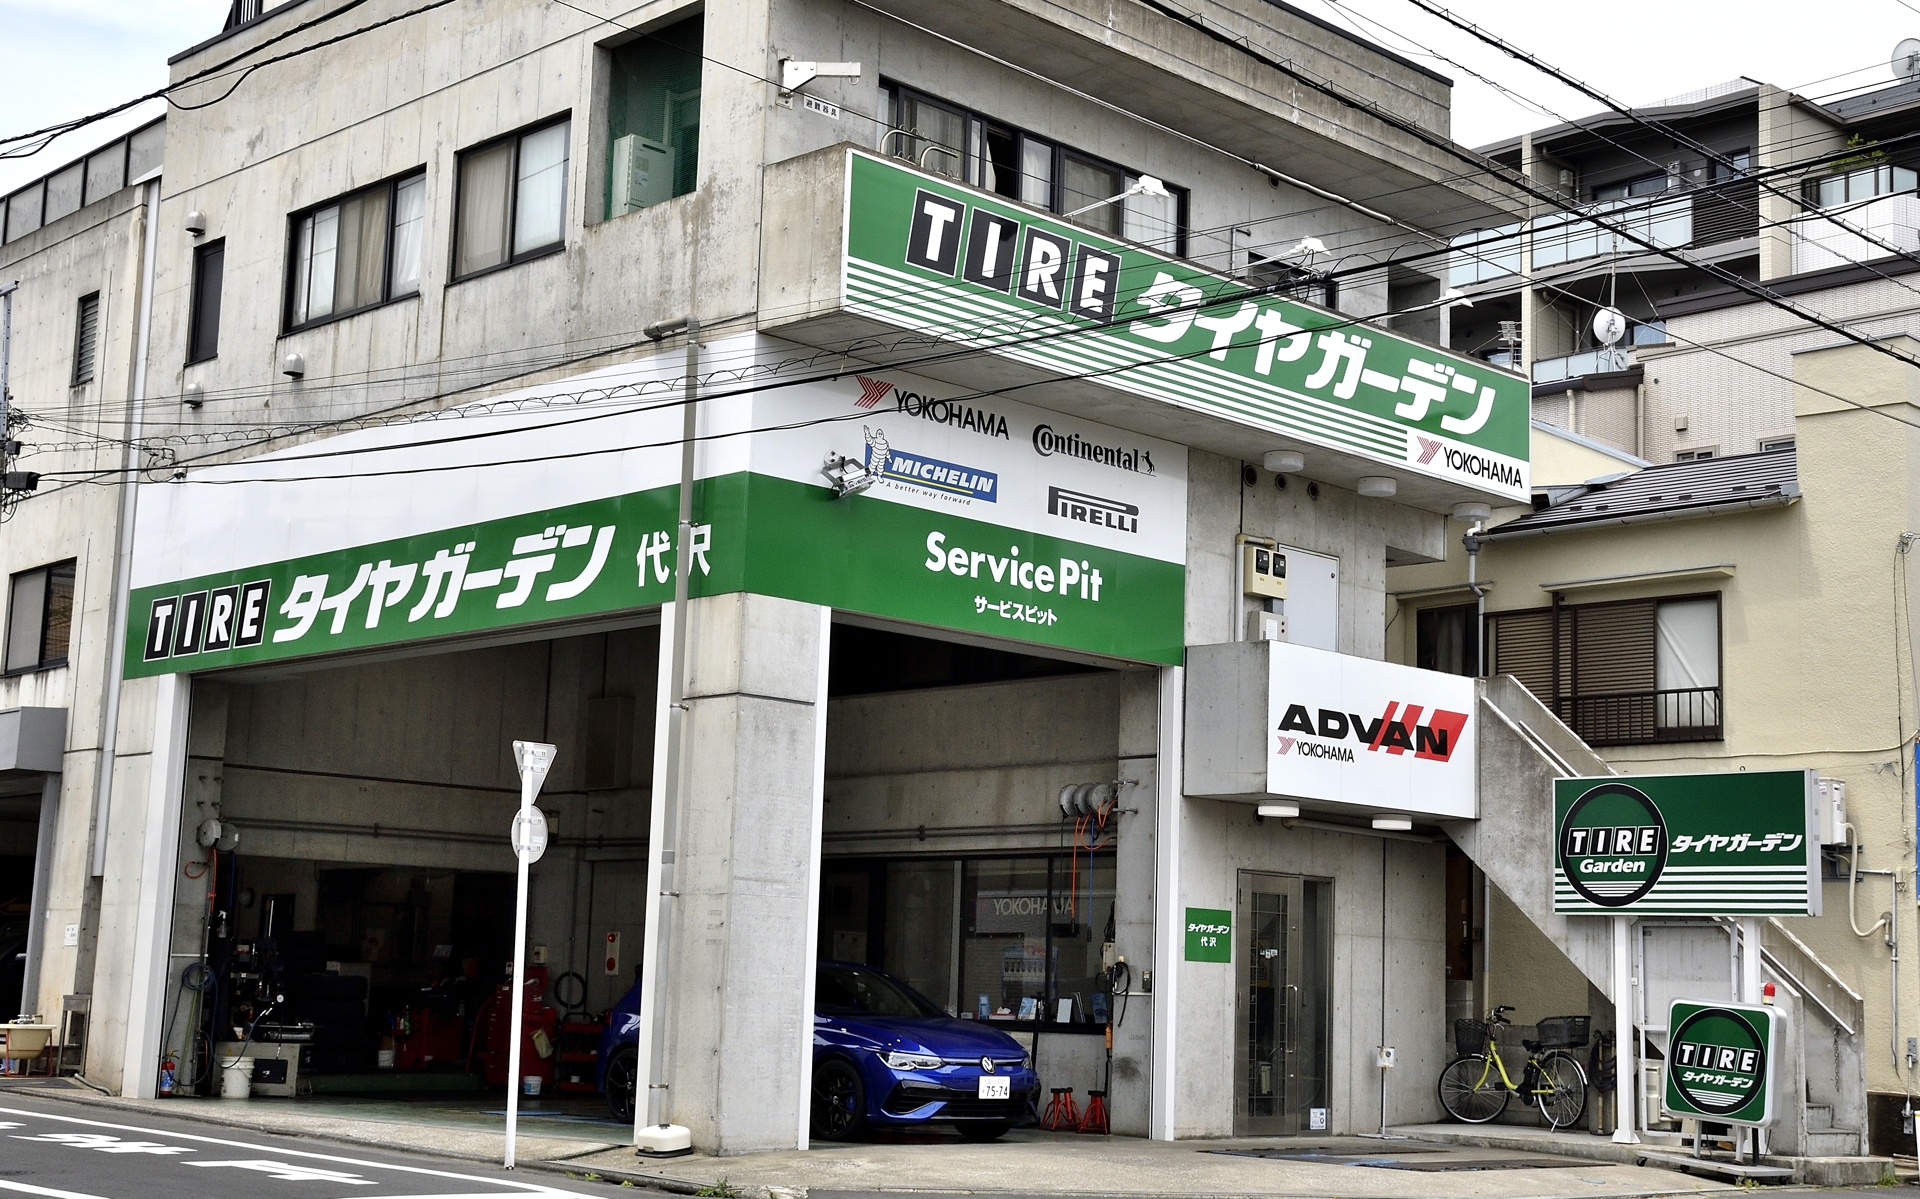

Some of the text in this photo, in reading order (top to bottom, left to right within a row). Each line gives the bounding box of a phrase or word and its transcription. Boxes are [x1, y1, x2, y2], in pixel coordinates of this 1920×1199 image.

[923, 200, 1496, 436] TIRE タイヤガーデン
[893, 388, 1010, 440] YOKOHAMA
[1032, 424, 1140, 473] Continental
[891, 457, 994, 493] MICHELIN
[1443, 446, 1523, 489] YOKOHAMA
[885, 481, 972, 506] A better way forward
[1047, 485, 1140, 534] PIRELLI
[924, 530, 1103, 602] Service Pit
[153, 588, 264, 652] TIRE
[272, 524, 616, 643] タイヤガーデン
[974, 595, 1058, 627] サービスピット
[1277, 703, 1448, 757] ADVAN
[1296, 740, 1355, 763] YOKOHAMA
[1572, 829, 1803, 853] TIRE タイヤガーデン
[1579, 858, 1646, 874] Garden
[1187, 923, 1230, 934] タイヤガーデン
[1200, 935, 1217, 947] 代沢
[1681, 1044, 1756, 1072] TIRE
[986, 1085, 1008, 1097] 75-74
[1682, 1071, 1754, 1089] タイヤガーデン
